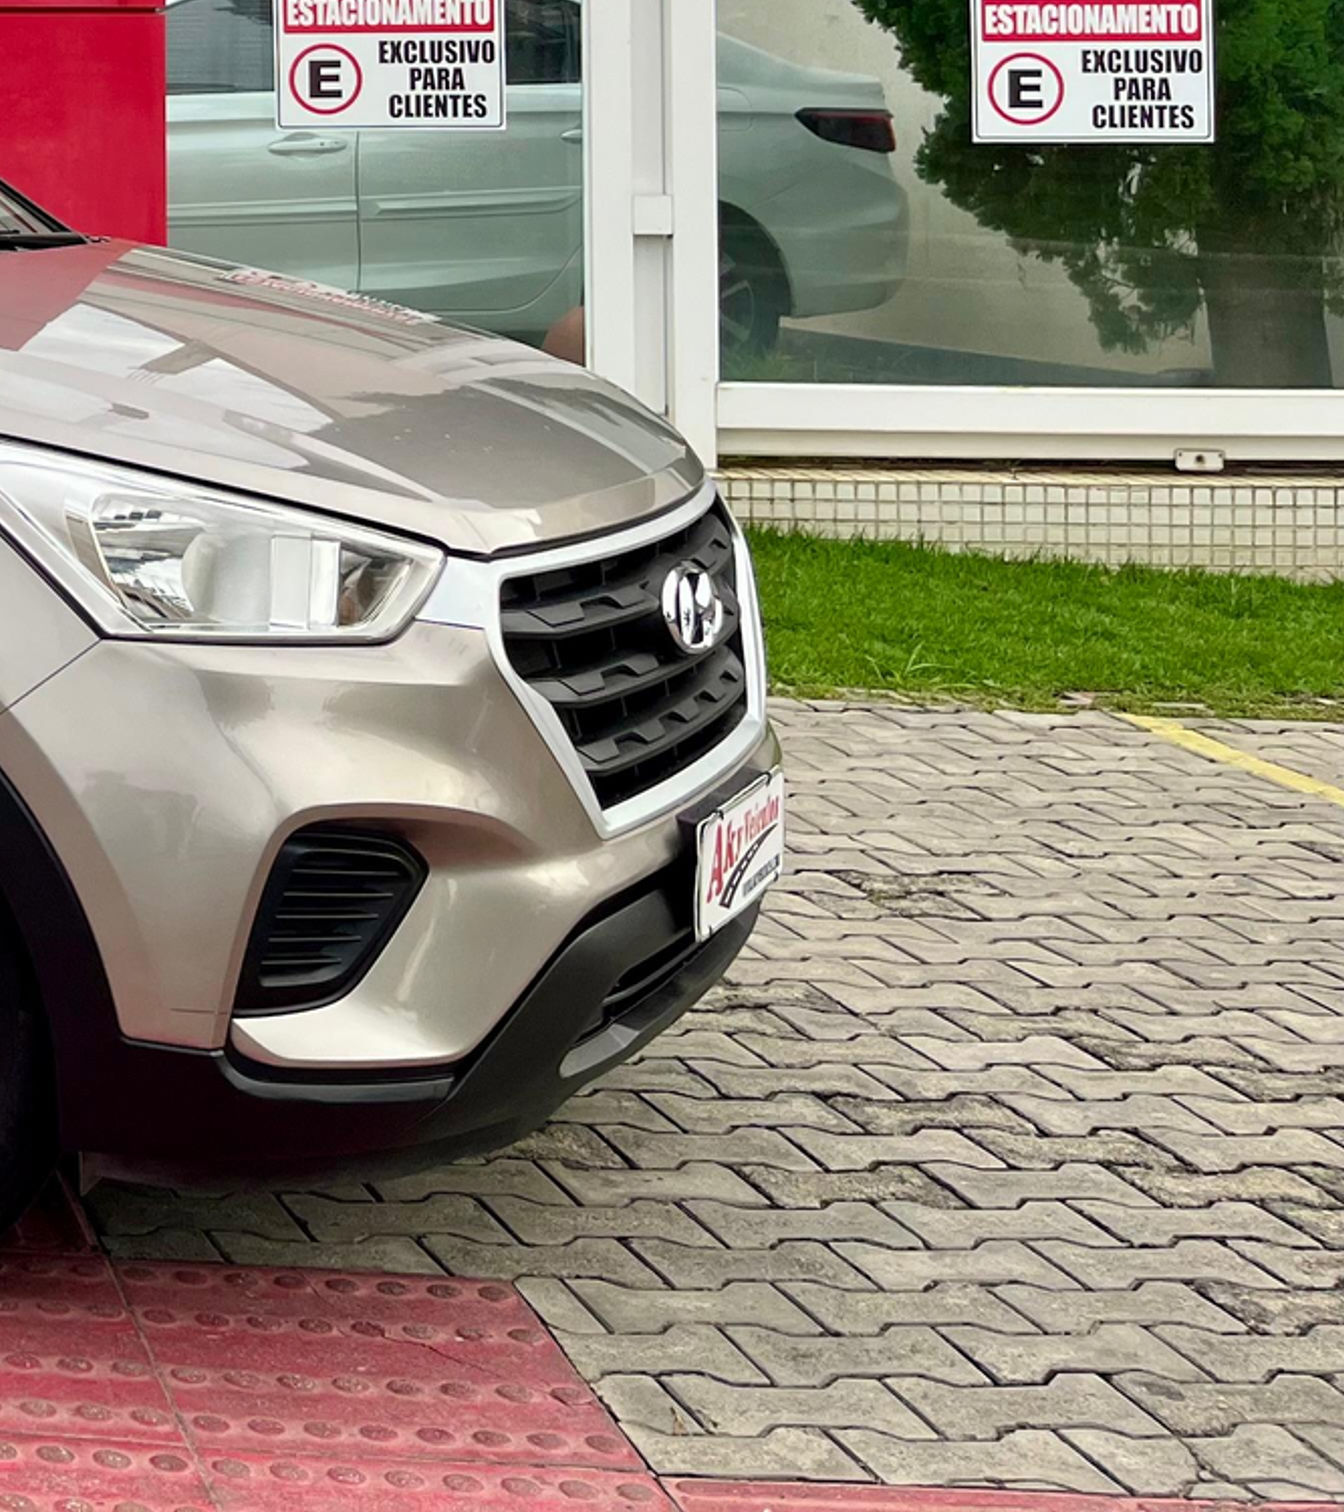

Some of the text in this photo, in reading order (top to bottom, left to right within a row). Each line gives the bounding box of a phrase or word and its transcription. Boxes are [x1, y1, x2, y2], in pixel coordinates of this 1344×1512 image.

[985, 3, 1198, 34] ESTACIONAMENTO
[378, 40, 495, 64] EXCLUSIVO
[1081, 49, 1203, 74] EXCLUSIVO
[308, 60, 342, 98] E
[410, 67, 465, 91] PARA
[1008, 69, 1043, 108] E
[1114, 77, 1172, 101] PARA
[389, 93, 487, 118] CLIENTES
[1092, 105, 1195, 129] CLIENTES
